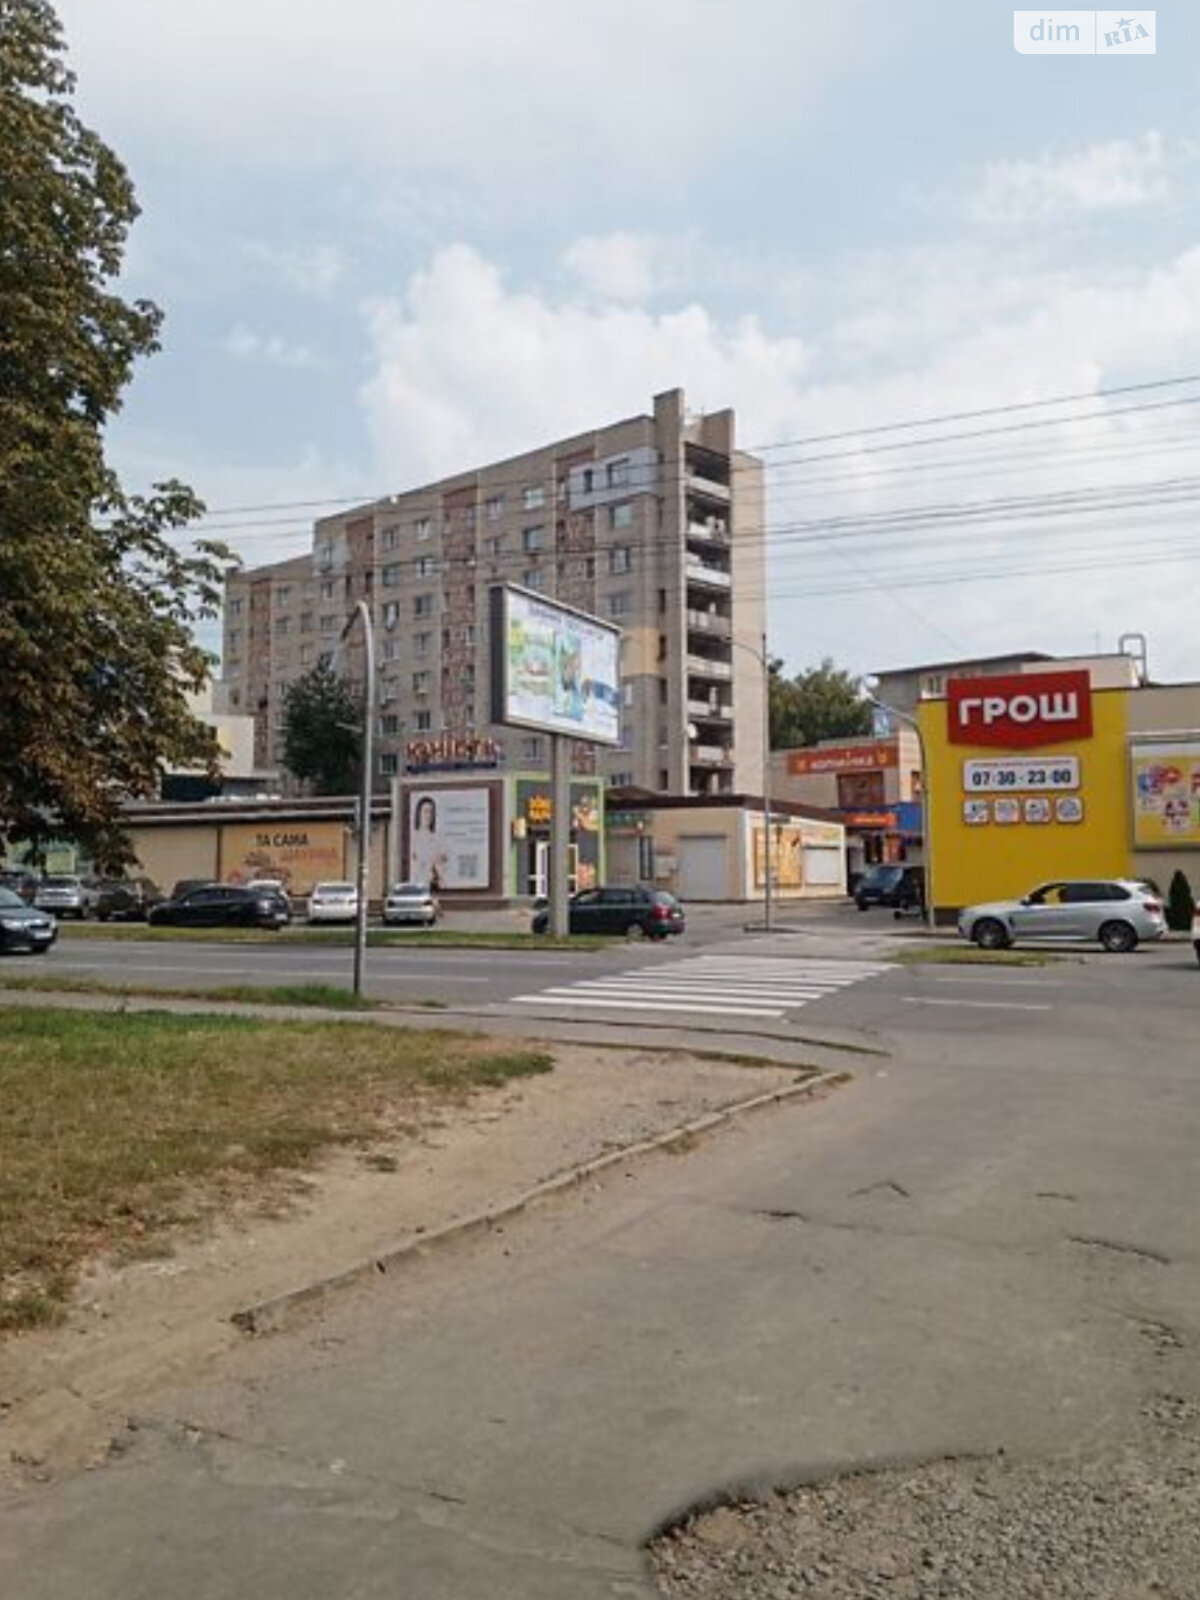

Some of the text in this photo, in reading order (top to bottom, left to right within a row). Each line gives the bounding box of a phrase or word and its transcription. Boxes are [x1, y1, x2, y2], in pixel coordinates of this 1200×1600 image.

[959, 692, 1078, 726] ГРОШ
[255, 831, 309, 847] ТА САМА
